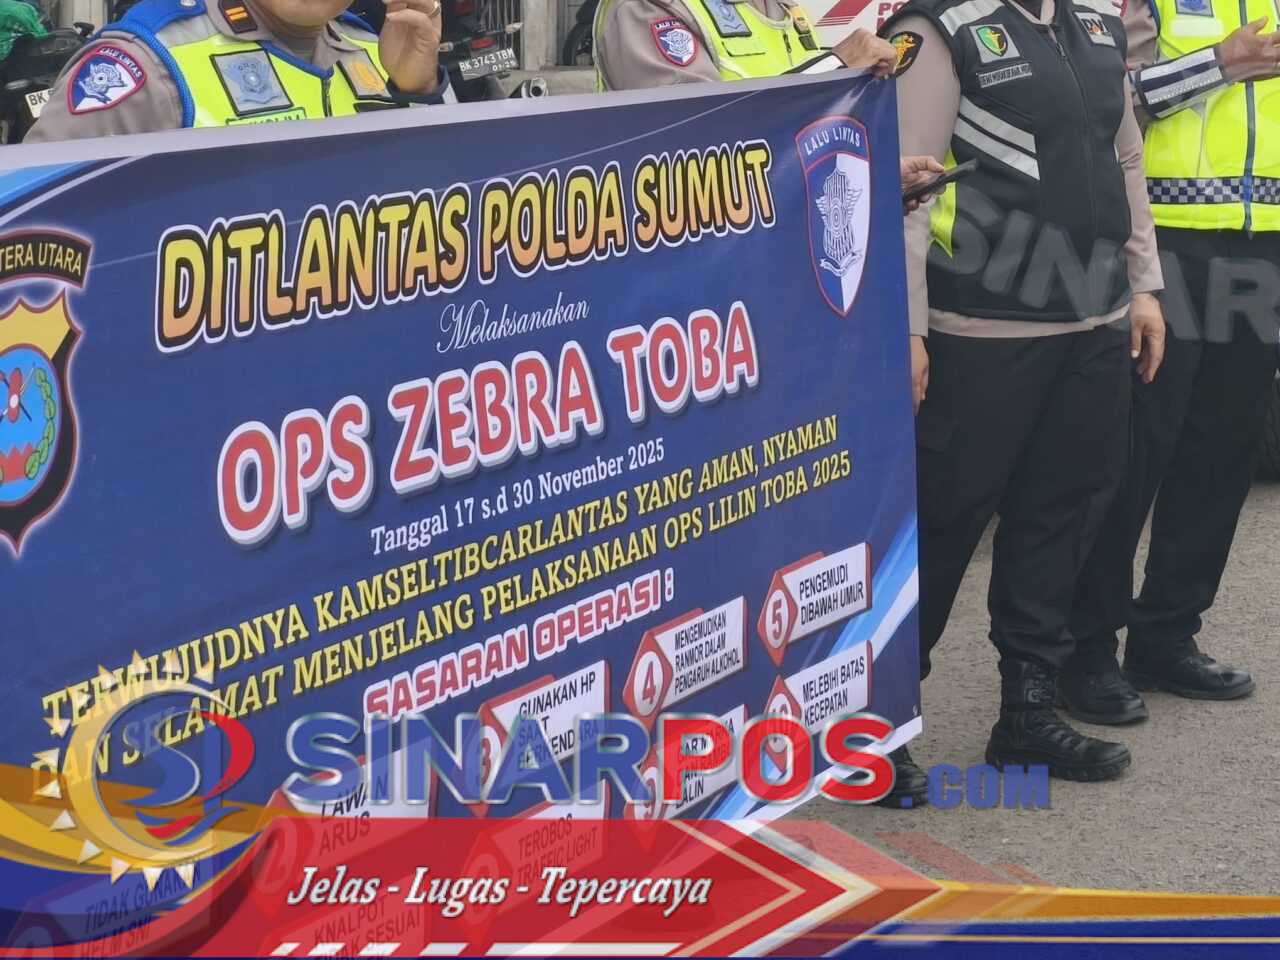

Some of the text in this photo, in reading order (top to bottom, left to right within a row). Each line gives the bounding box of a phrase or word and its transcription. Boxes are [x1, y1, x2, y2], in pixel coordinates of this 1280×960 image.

[458, 47, 515, 72] BK 3743 TBM
[28, 92, 47, 106] BK
[804, 126, 861, 156] LALU LINTAS
[38, 242, 82, 276] UTARA
[156, 139, 776, 353] DITLANTAS POLDA SUMUT
[437, 292, 590, 353] Melaksanakan
[218, 301, 760, 545] OPS ZEBRA TOBA
[370, 438, 665, 556] Tanggal 17 s.d 30 November 2025
[313, 490, 629, 633] KAMSELTIBCARLANTAS
[635, 468, 694, 516] YANG
[698, 446, 760, 495] AMAN,
[762, 414, 838, 470] NYAMAN
[292, 594, 475, 695] MENJELANG
[482, 524, 658, 622] PELAKSANAAN
[663, 510, 702, 554] OPS
[708, 487, 758, 532] LILIN
[761, 466, 810, 509] TOBA
[812, 450, 852, 489] 2025
[799, 563, 849, 602] PENGEMUDI
[771, 599, 783, 641] 5
[800, 581, 865, 627] DIBAWAH UMUR
[364, 624, 529, 725] SASARAN
[534, 570, 661, 661] OPERASI
[674, 609, 727, 651] MENGEMUDIKAN
[675, 631, 727, 673] RANMOR DALAM
[519, 670, 597, 716] GUNAKAN HP
[641, 660, 657, 702] 4
[674, 647, 741, 696] PENGARUH ALKOHOL
[802, 656, 865, 704] MELEBIHI BATAS
[804, 689, 849, 727] KECEPATAN
[518, 813, 573, 861] TEROBOS
